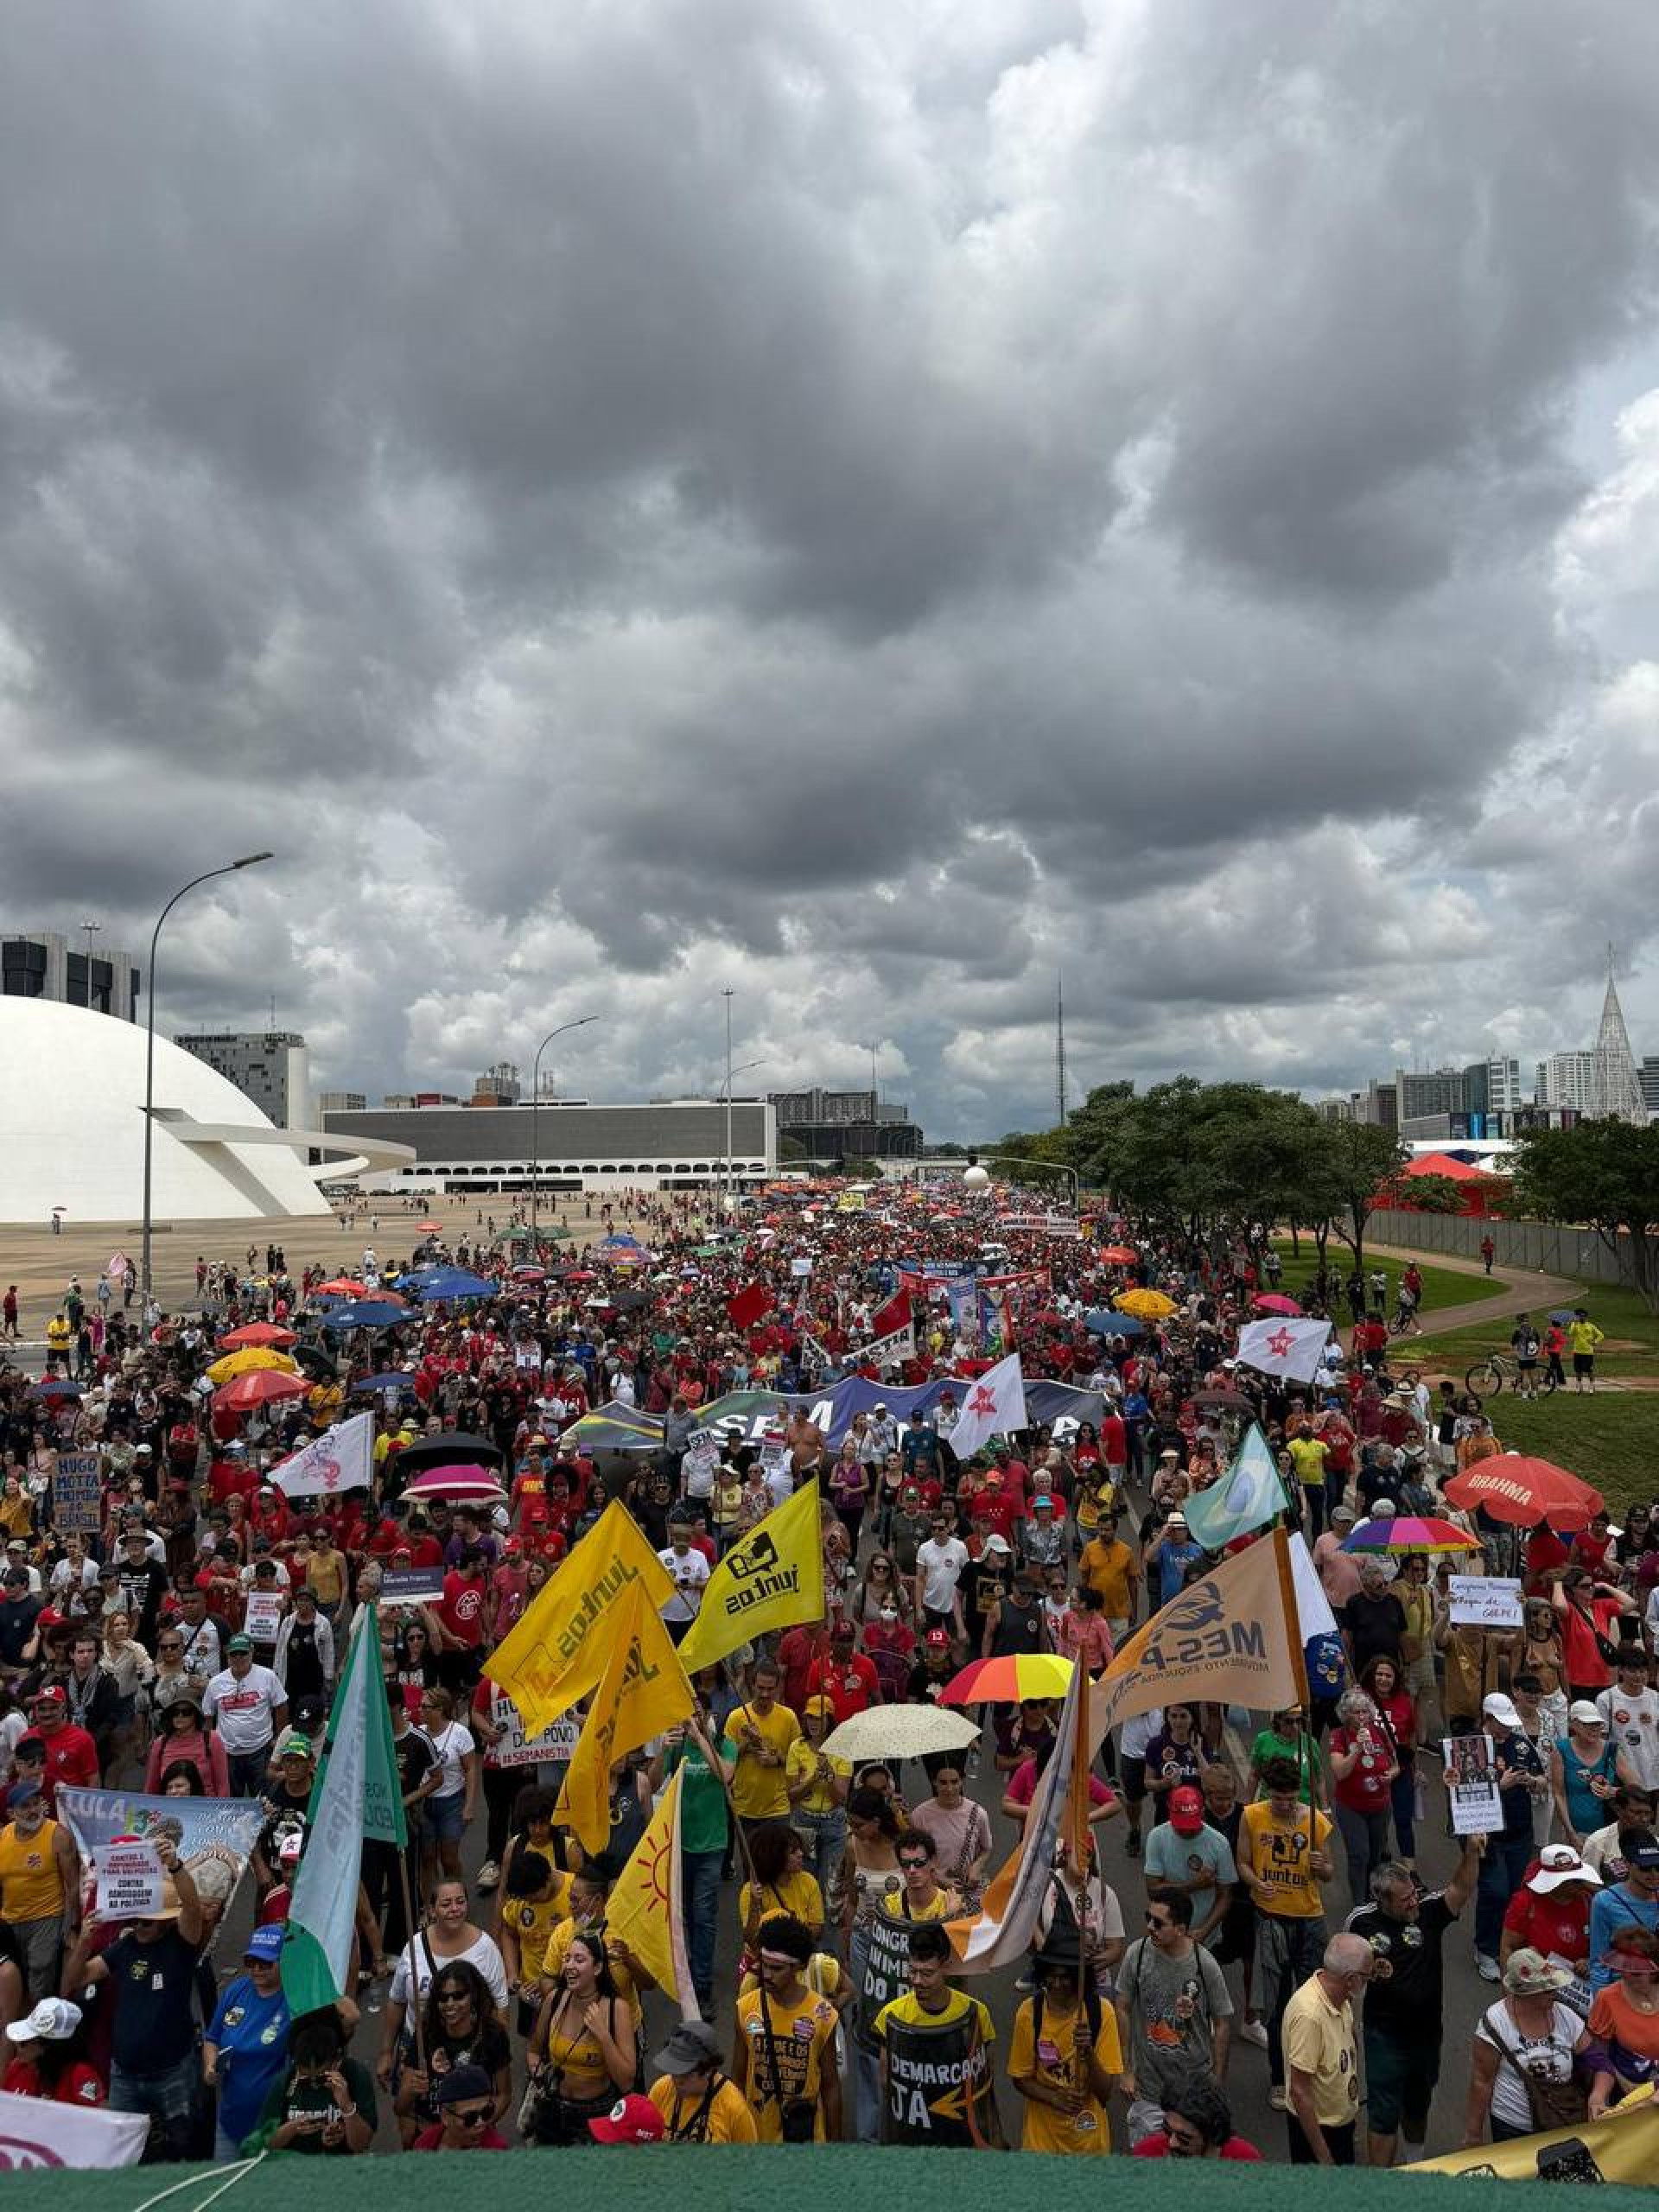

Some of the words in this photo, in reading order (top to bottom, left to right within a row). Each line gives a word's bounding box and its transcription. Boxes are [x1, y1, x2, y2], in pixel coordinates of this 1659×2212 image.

[58, 1458, 97, 1474] HUGO
[55, 1475, 99, 1491] MOTTA
[1468, 1474, 1532, 1506] BRAHMA
[932, 1632, 944, 1641] 13
[543, 1726, 574, 1744] POVO
[872, 1921, 910, 1953] CONGR
[869, 1946, 910, 1979] INIM
[864, 1967, 887, 2001] DO
[890, 2079, 933, 2130] JÁ
